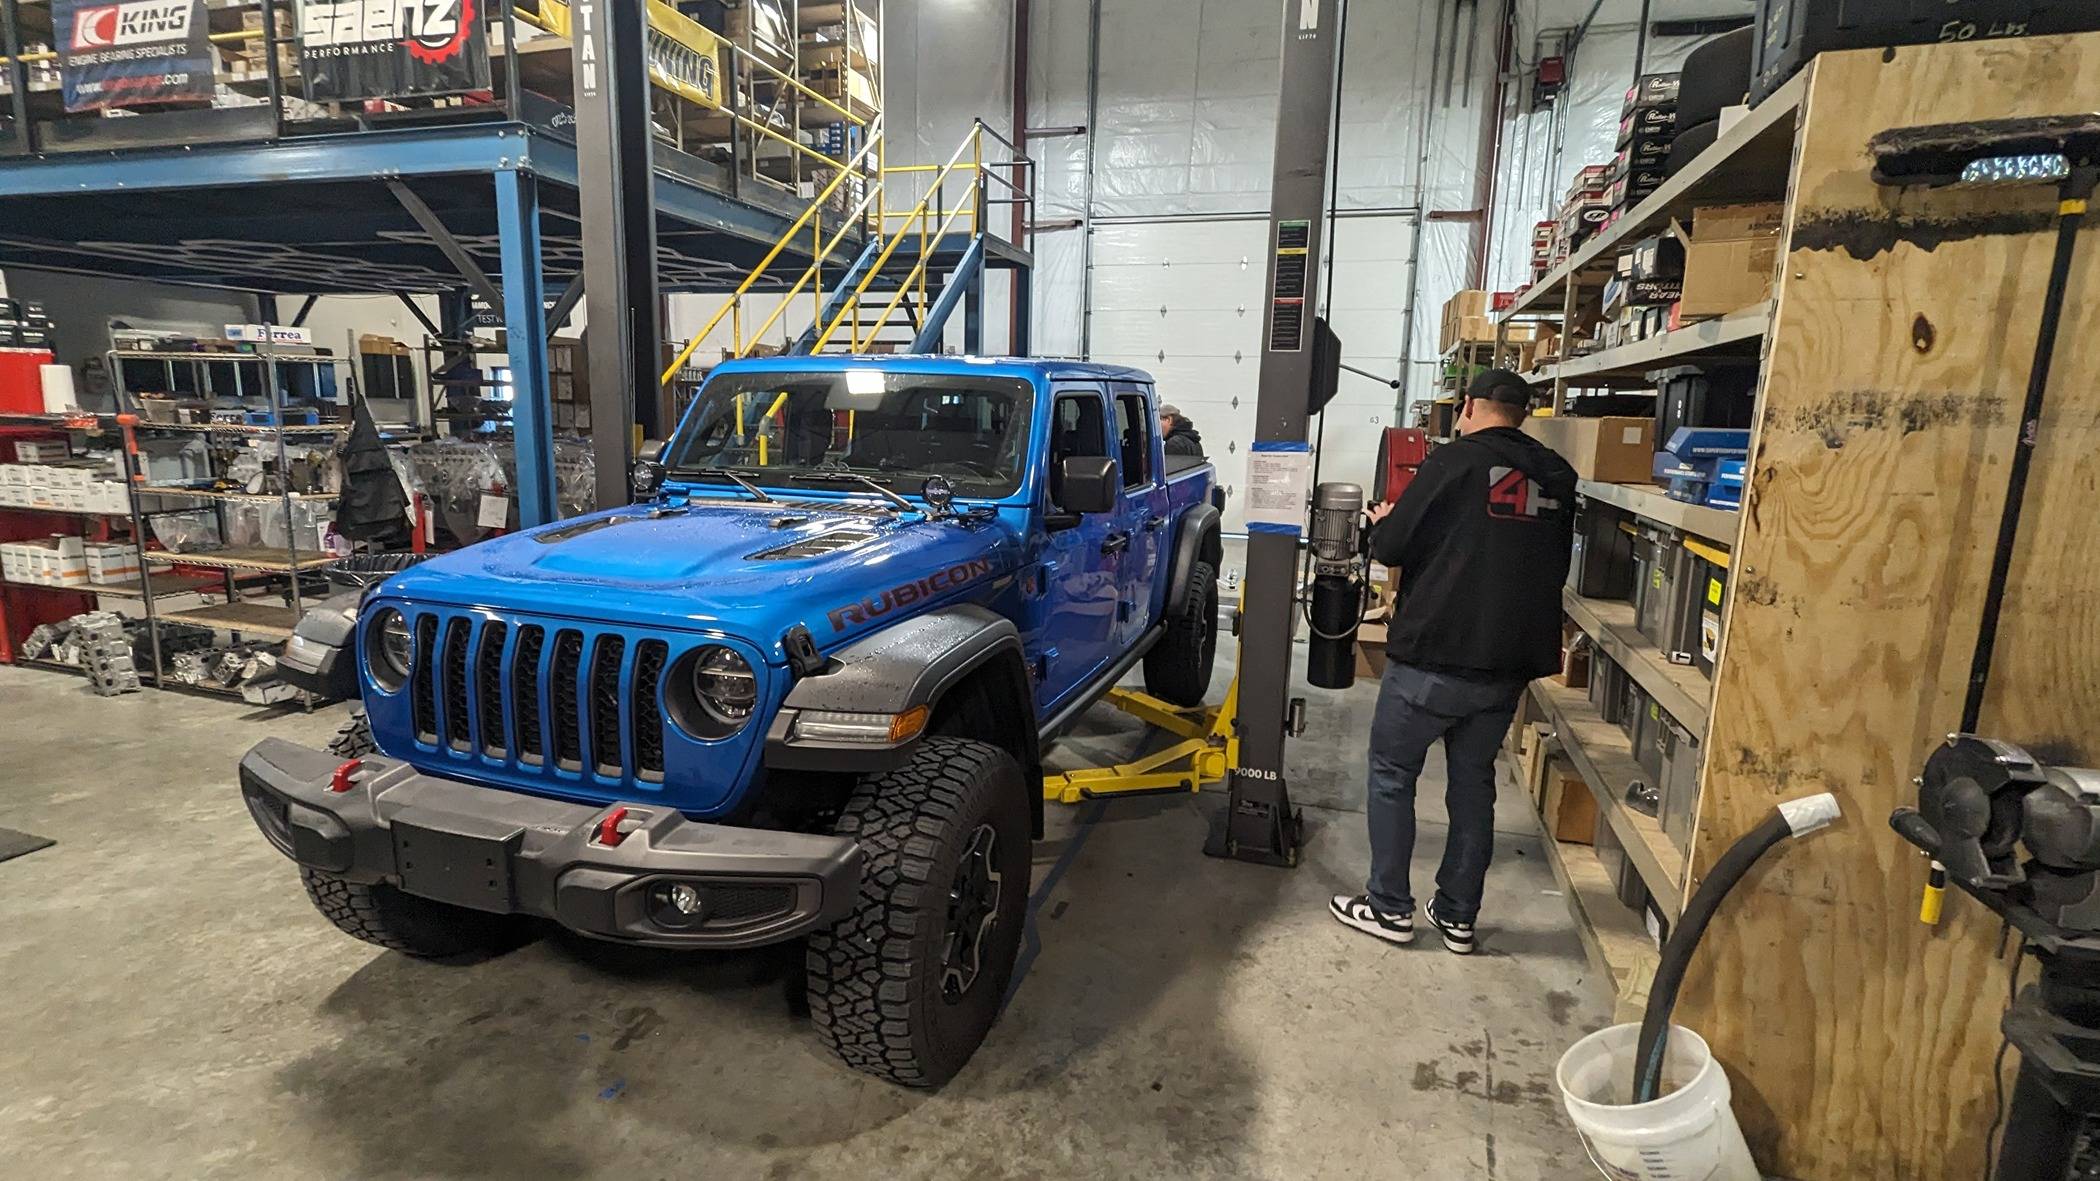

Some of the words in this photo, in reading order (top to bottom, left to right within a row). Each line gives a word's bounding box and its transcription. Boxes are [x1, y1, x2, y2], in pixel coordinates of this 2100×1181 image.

[120, 4, 188, 36] KING
[1936, 20, 1977, 43] 50
[135, 43, 188, 60] SPECIALISTS
[303, 43, 395, 59] PERFORMANCE
[579, 0, 597, 89] TAN
[827, 555, 993, 632] RUBICON
[1263, 770, 1277, 781] LB
